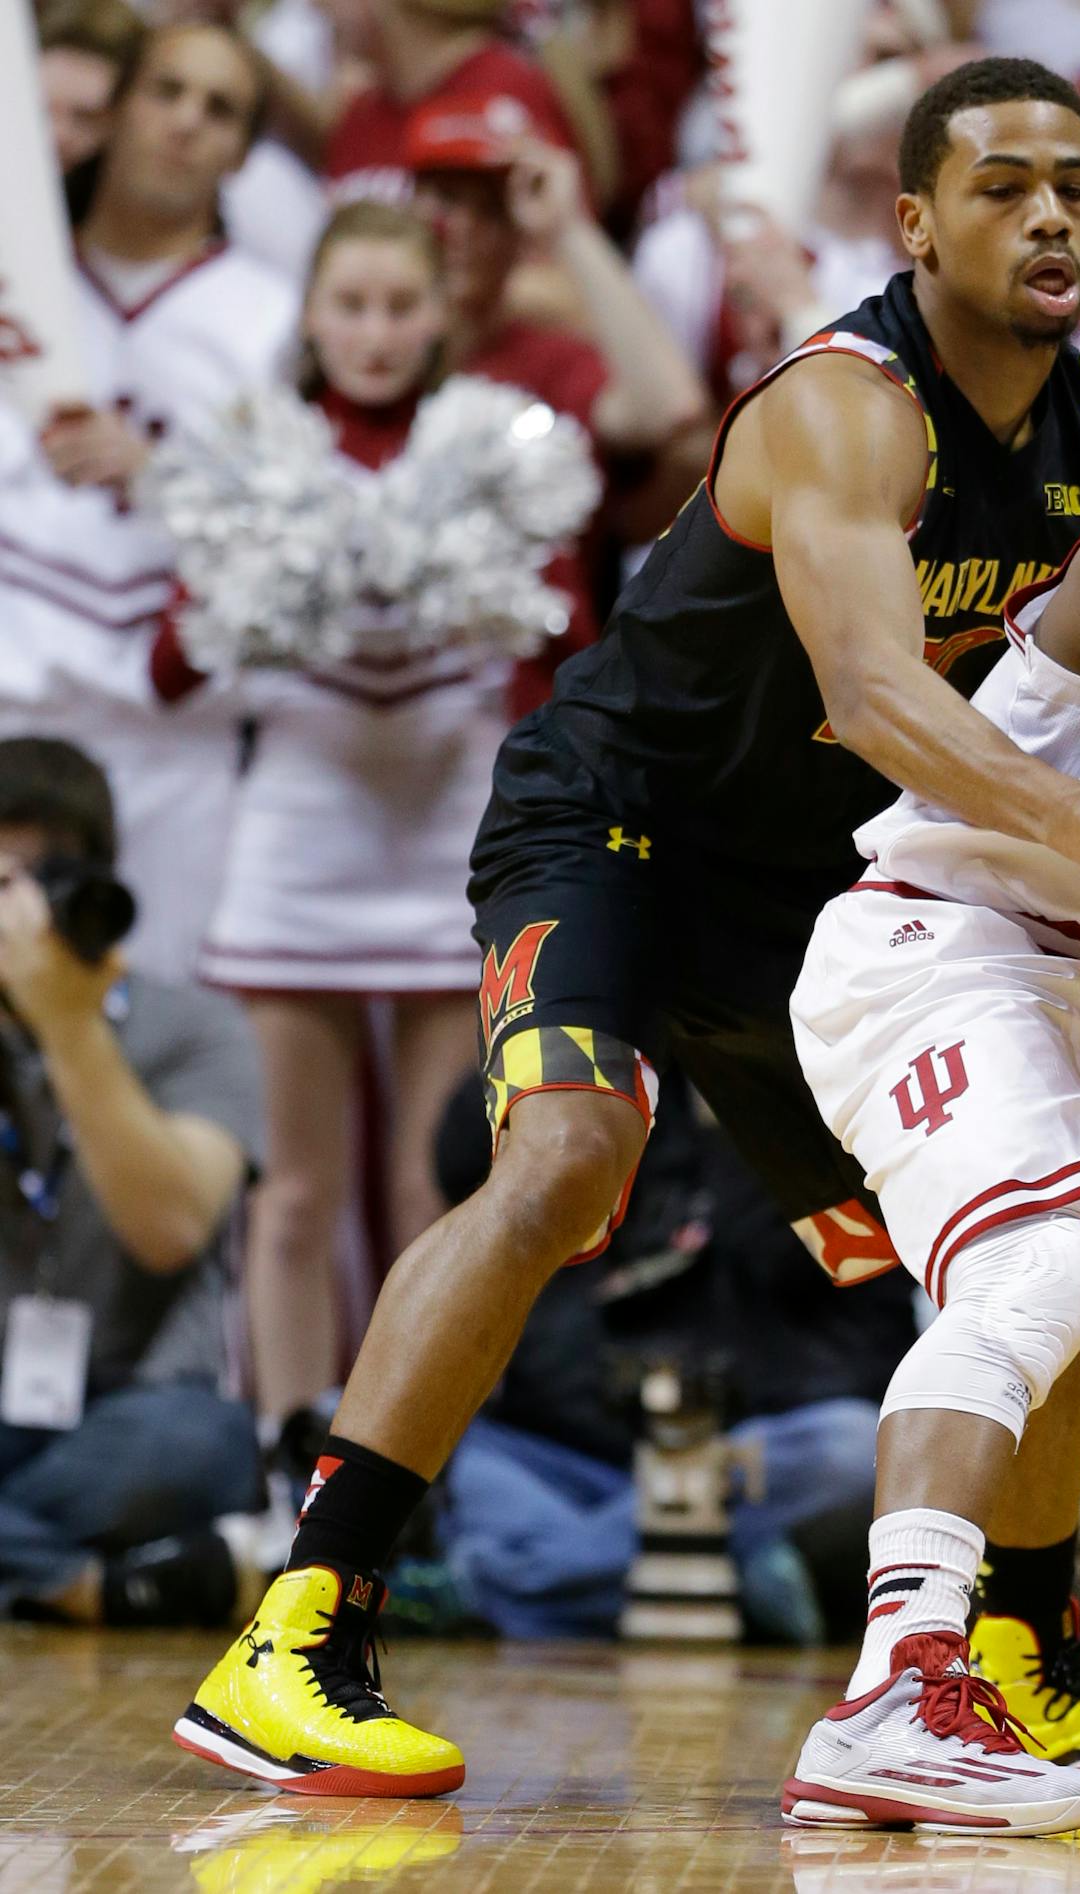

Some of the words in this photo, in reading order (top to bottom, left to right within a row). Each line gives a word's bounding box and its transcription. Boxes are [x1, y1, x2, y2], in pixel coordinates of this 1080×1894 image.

[889, 930, 935, 948] adidas
[479, 920, 560, 1052] M
[346, 1573, 374, 1611] M
